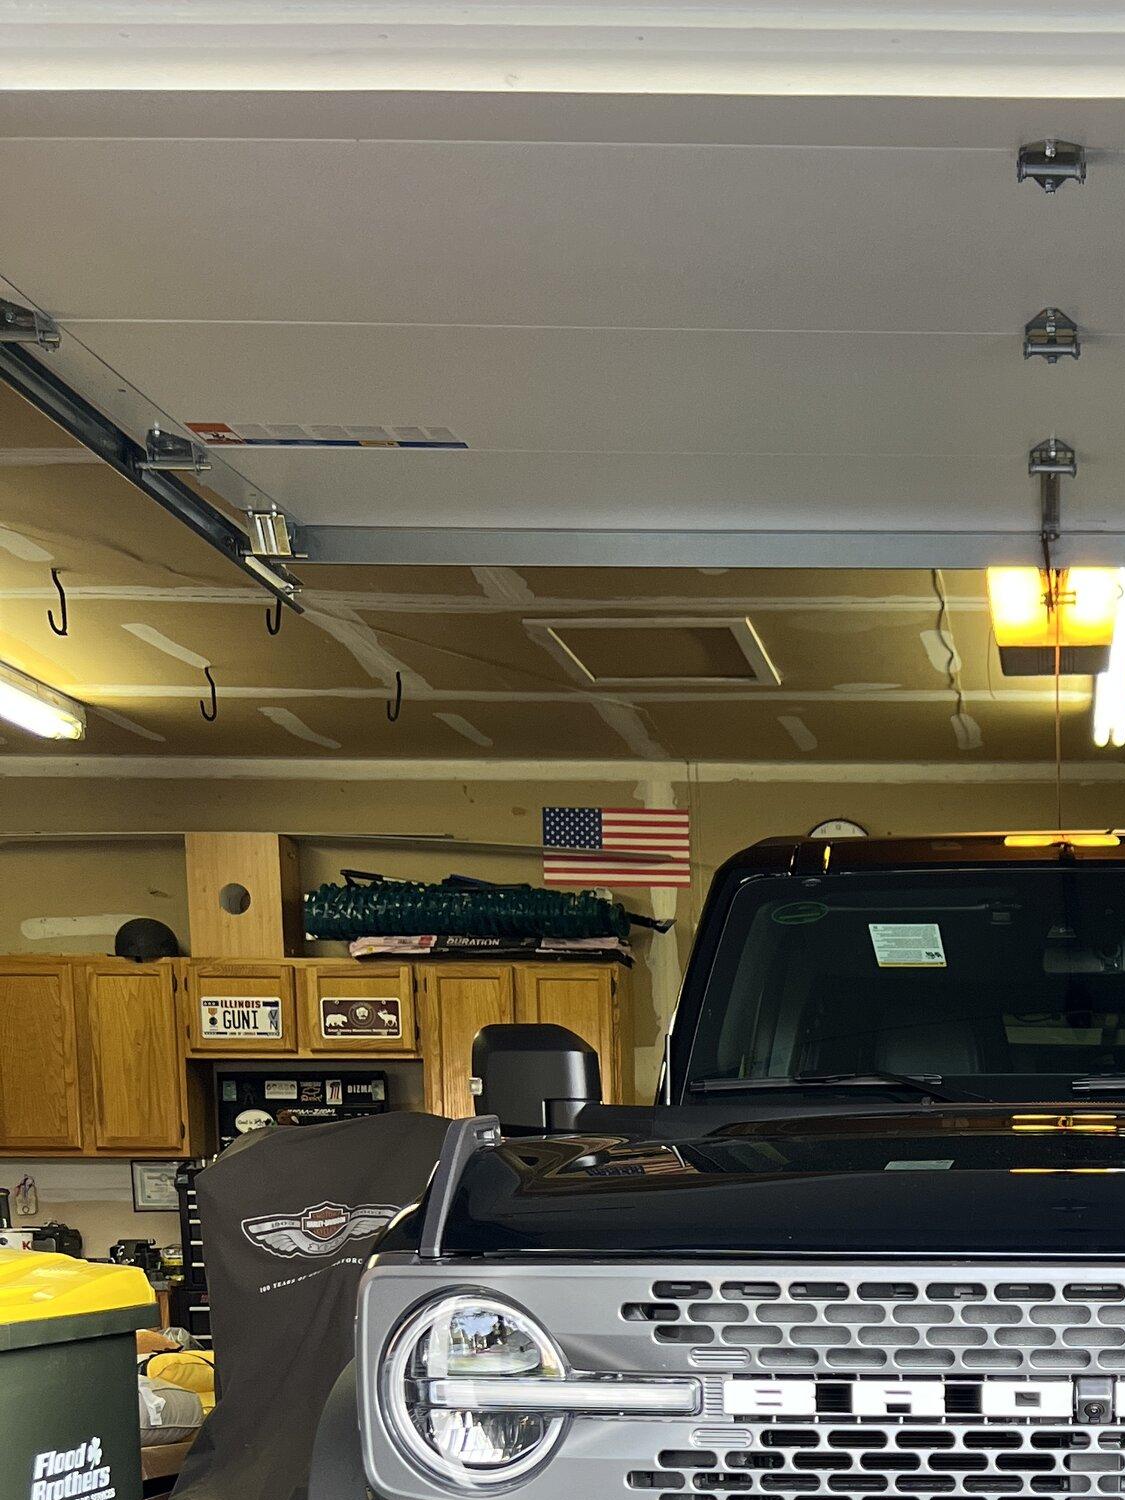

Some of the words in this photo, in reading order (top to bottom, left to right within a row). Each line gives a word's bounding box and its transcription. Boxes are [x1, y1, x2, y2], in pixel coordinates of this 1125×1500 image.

[446, 936, 500, 946] DURATION
[220, 1000, 261, 1009] ILLINOIS
[222, 1010, 259, 1029] GUNI
[273, 1278, 296, 1289] YEARS
[33, 1442, 87, 1480] Flood
